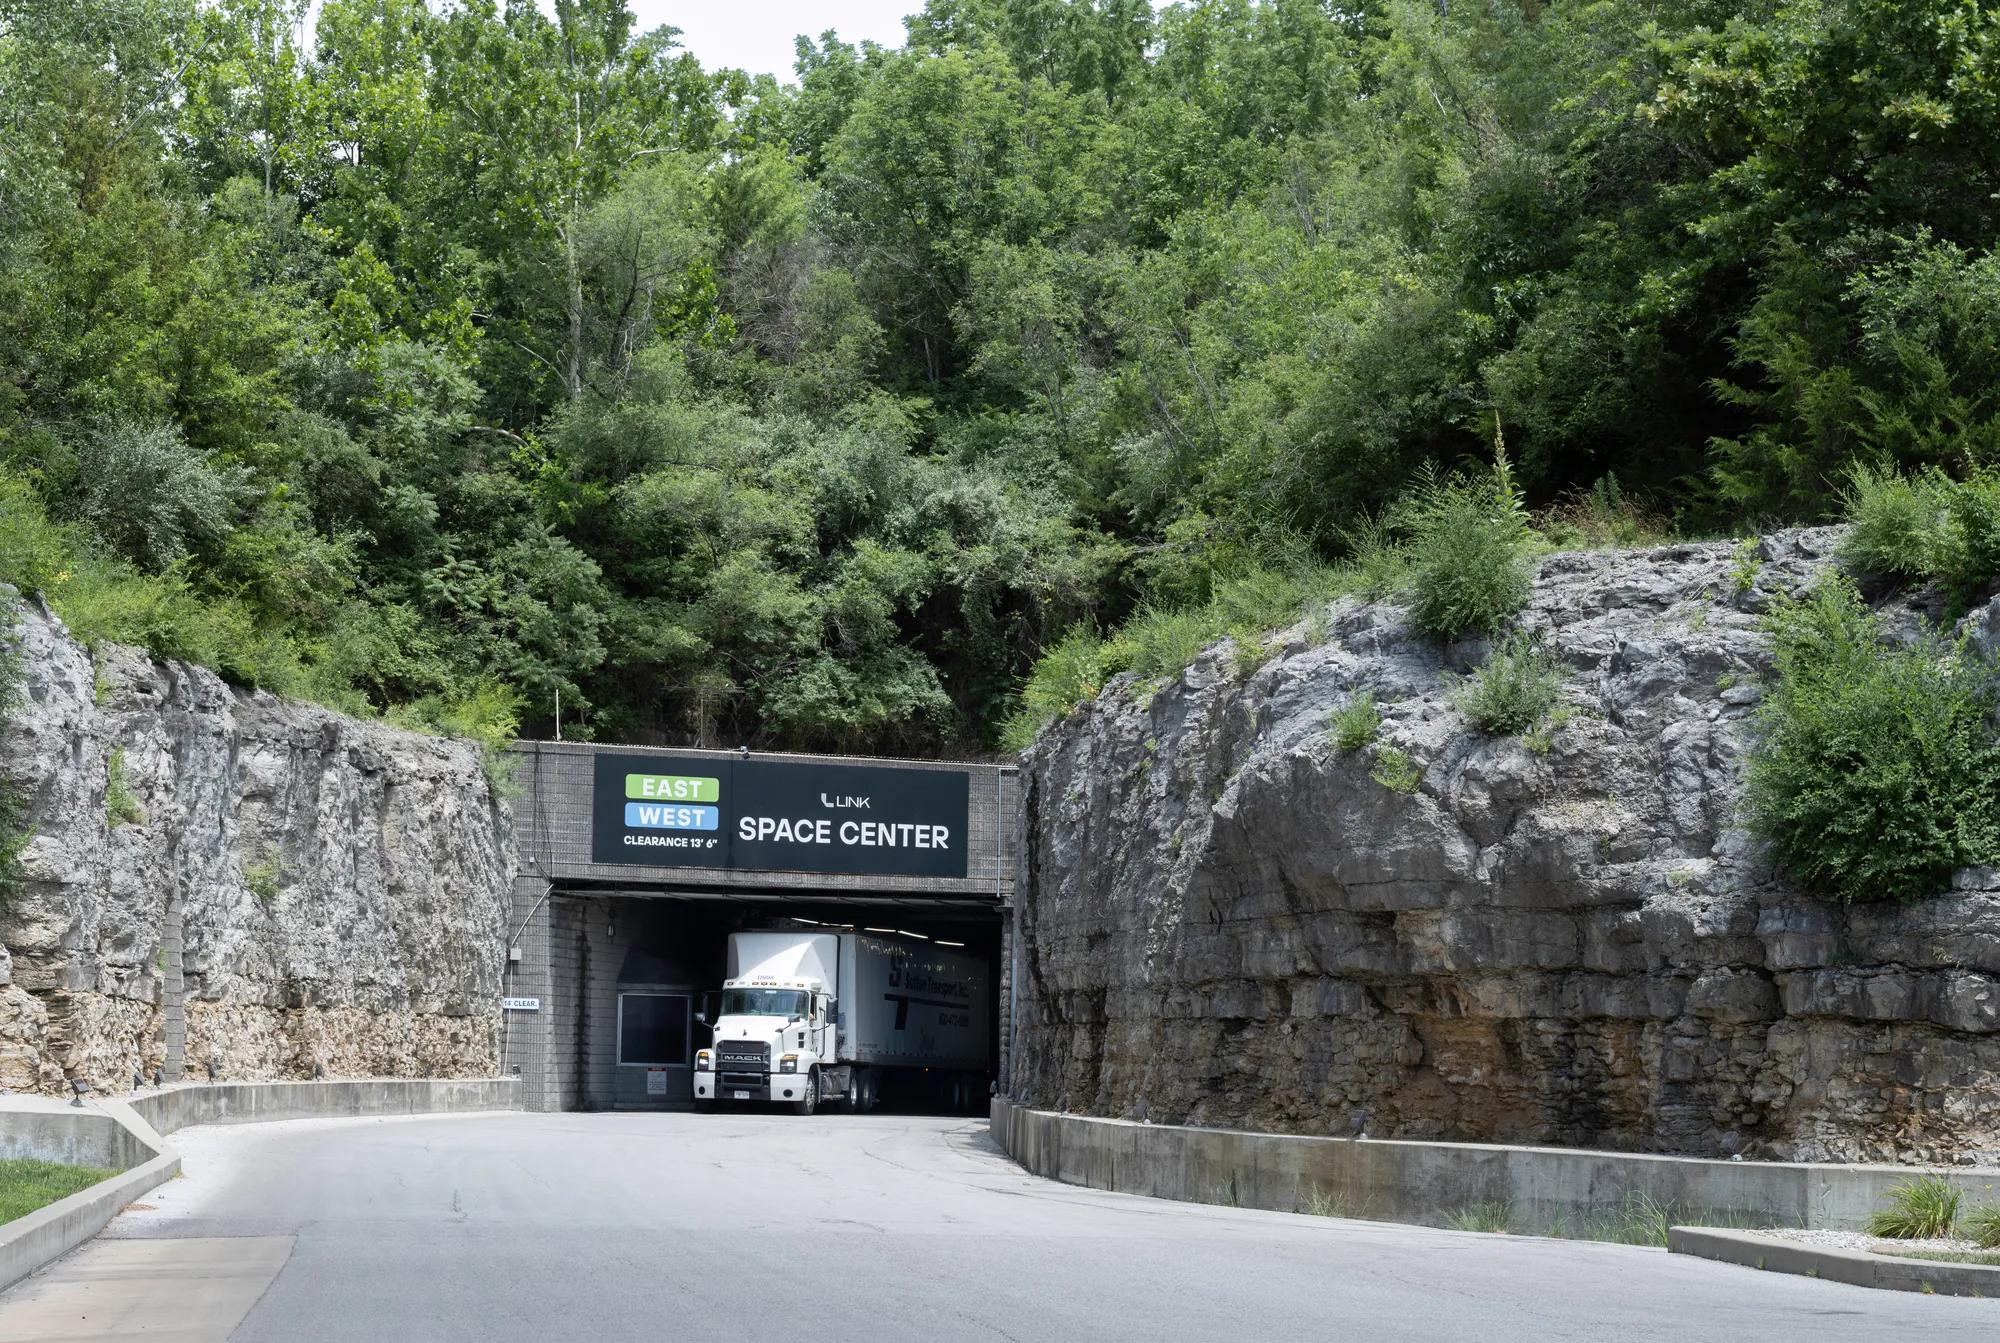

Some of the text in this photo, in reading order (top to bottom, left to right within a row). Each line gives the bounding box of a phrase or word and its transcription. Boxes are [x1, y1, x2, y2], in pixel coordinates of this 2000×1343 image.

[642, 778, 703, 798] EAST
[836, 795, 870, 809] LINK
[638, 806, 705, 827] WEST
[623, 834, 688, 848] CLEARANCE
[690, 837, 704, 848] 13'
[738, 816, 949, 849] SPACE CENTER
